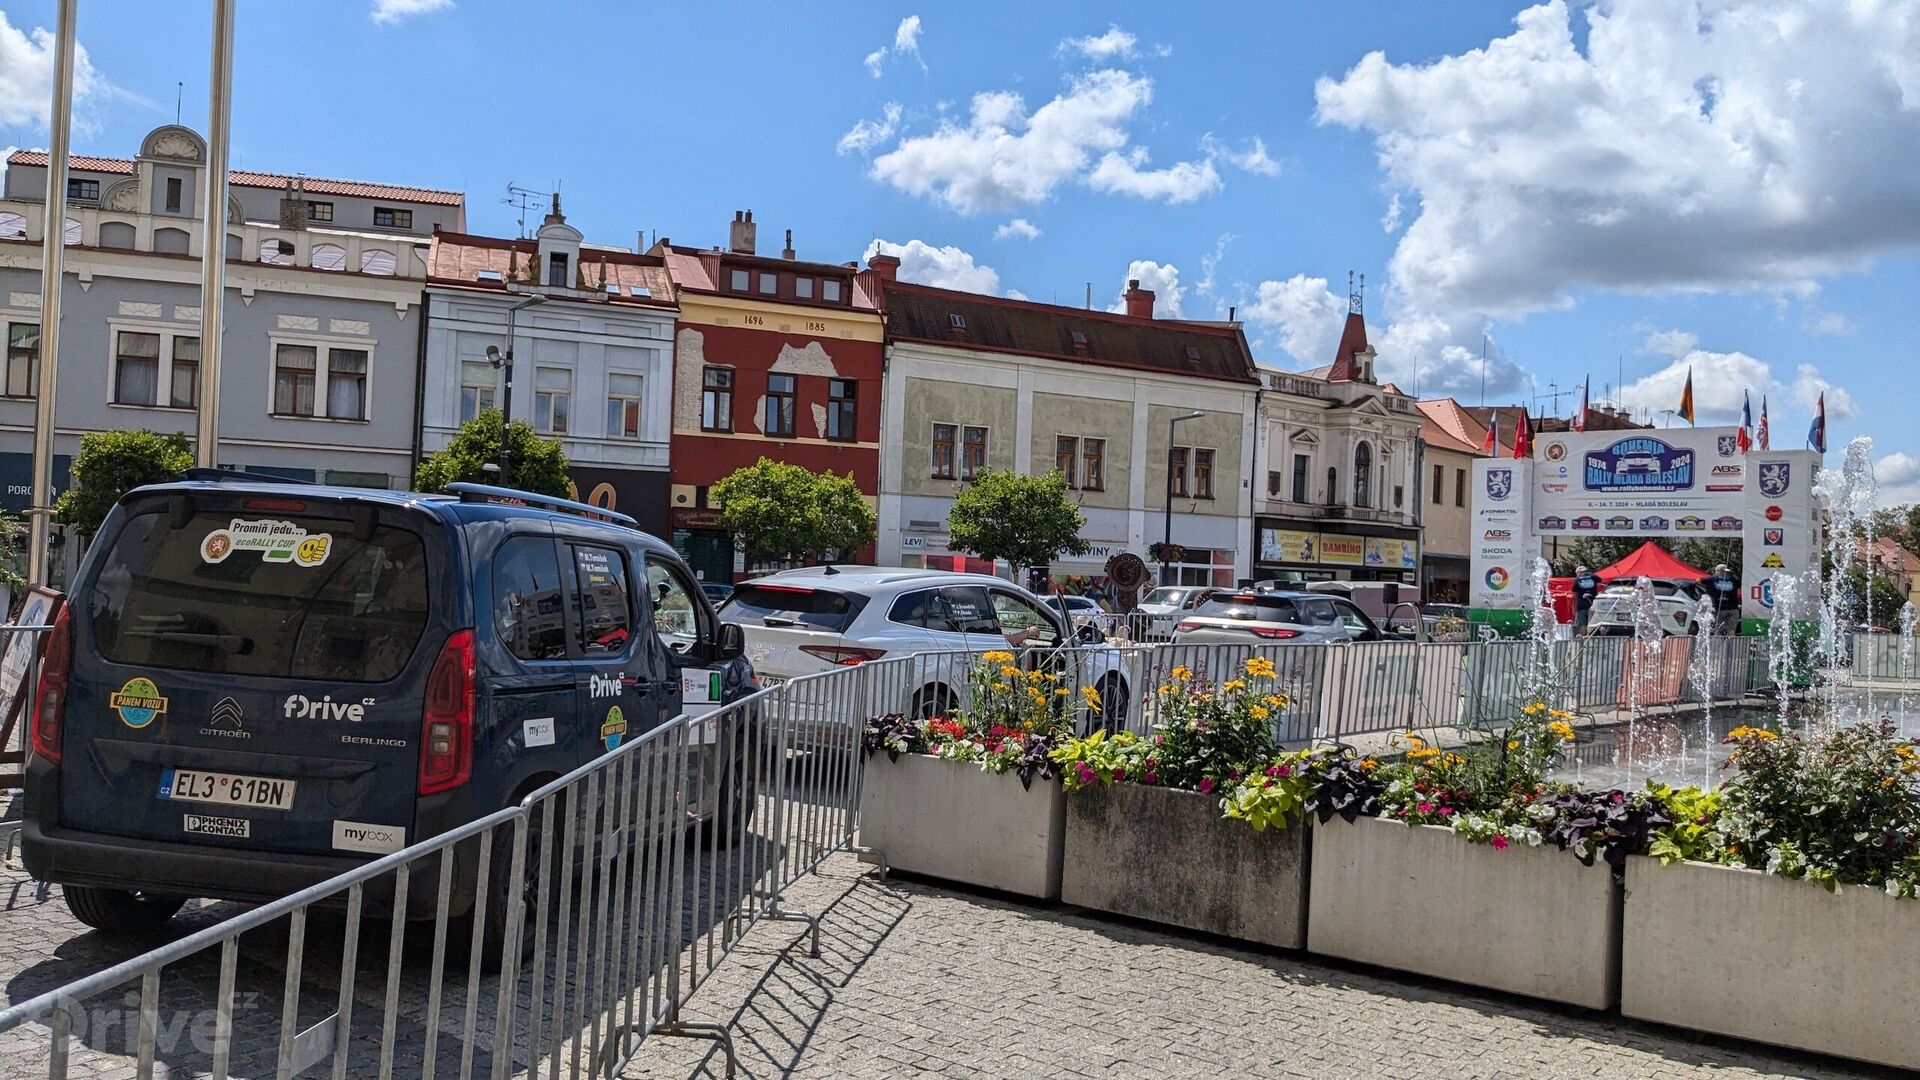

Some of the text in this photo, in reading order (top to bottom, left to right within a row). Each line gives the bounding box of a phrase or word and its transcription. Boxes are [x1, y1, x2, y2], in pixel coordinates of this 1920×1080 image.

[744, 315, 826, 332] 1696 1885
[1612, 439, 1665, 455] BOHEMIA
[1588, 457, 1607, 470] 1974
[1670, 454, 1690, 469] 2024
[1587, 466, 1613, 485] RALLY
[1645, 465, 1690, 485] BOLESLAV
[1711, 465, 1741, 473] ABS
[7, 484, 57, 496] PORCN
[1484, 529, 1511, 537] ABS
[235, 538, 296, 548] ecoRALLY CUP
[904, 538, 922, 546] LEVI
[117, 696, 161, 709] PANEM VOZU
[341, 735, 407, 747] BERLINGO
[160, 773, 285, 806] CZ EL3 61BN
[201, 825, 247, 836] CONTACT
[344, 828, 393, 843] mybox
